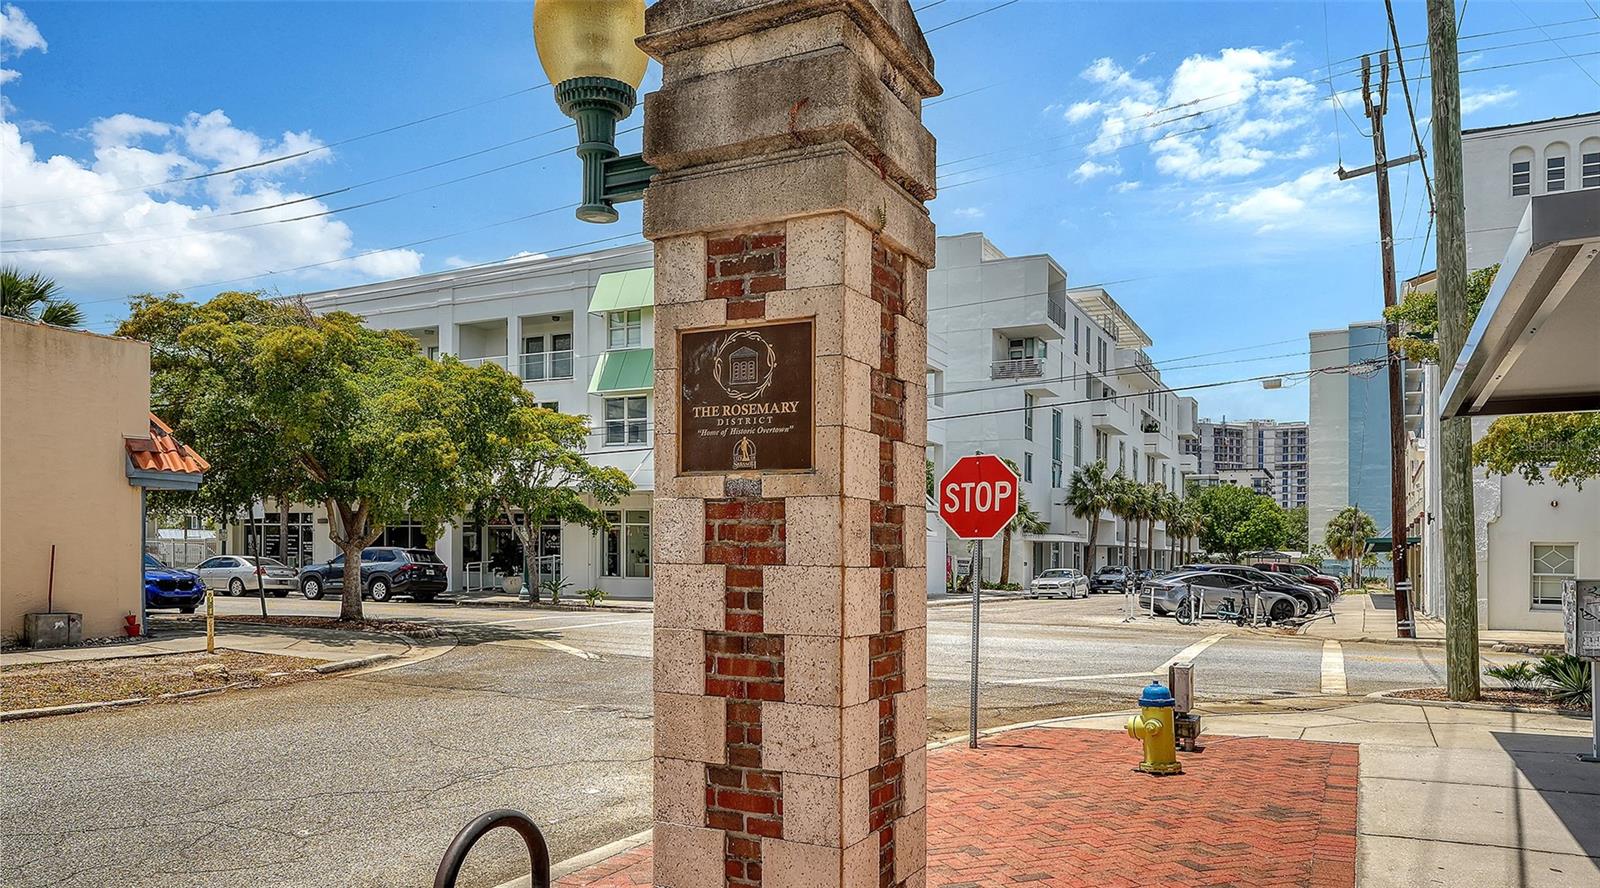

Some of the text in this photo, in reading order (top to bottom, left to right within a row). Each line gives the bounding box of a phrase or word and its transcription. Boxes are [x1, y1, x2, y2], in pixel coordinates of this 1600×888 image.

[692, 401, 800, 418] THE ROSEMARY
[717, 416, 774, 426] DISTRICT
[720, 427, 728, 437] of
[730, 426, 755, 435] Historic
[944, 481, 1012, 513] STOP
